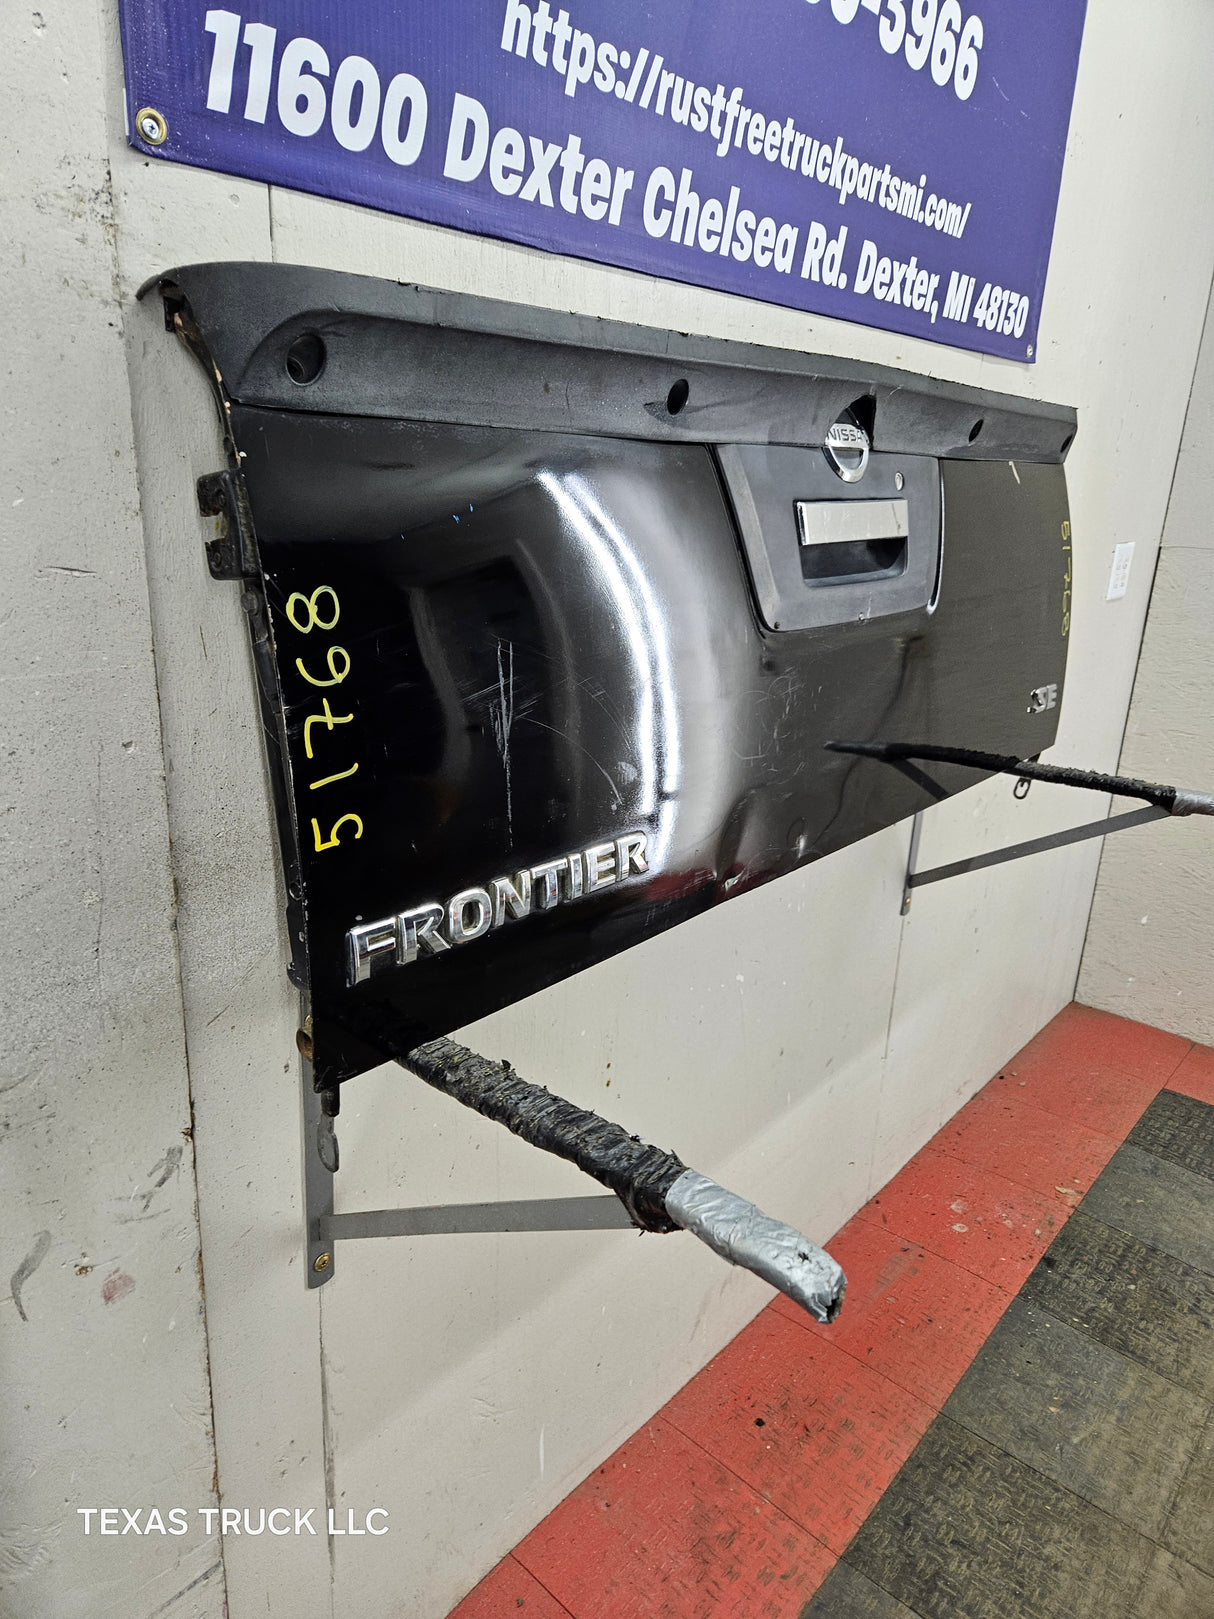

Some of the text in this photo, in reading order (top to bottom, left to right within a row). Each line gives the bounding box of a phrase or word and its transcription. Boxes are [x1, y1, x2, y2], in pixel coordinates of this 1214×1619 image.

[204, 9, 1030, 339] 11600 Dexter Chelsea Rd. Dexter, MI 48130
[501, 0, 971, 239] https://rustfreetruckpartsmi.com/
[286, 584, 364, 853] 51768
[1026, 683, 1058, 714] SE
[346, 831, 650, 988] FRONTIER
